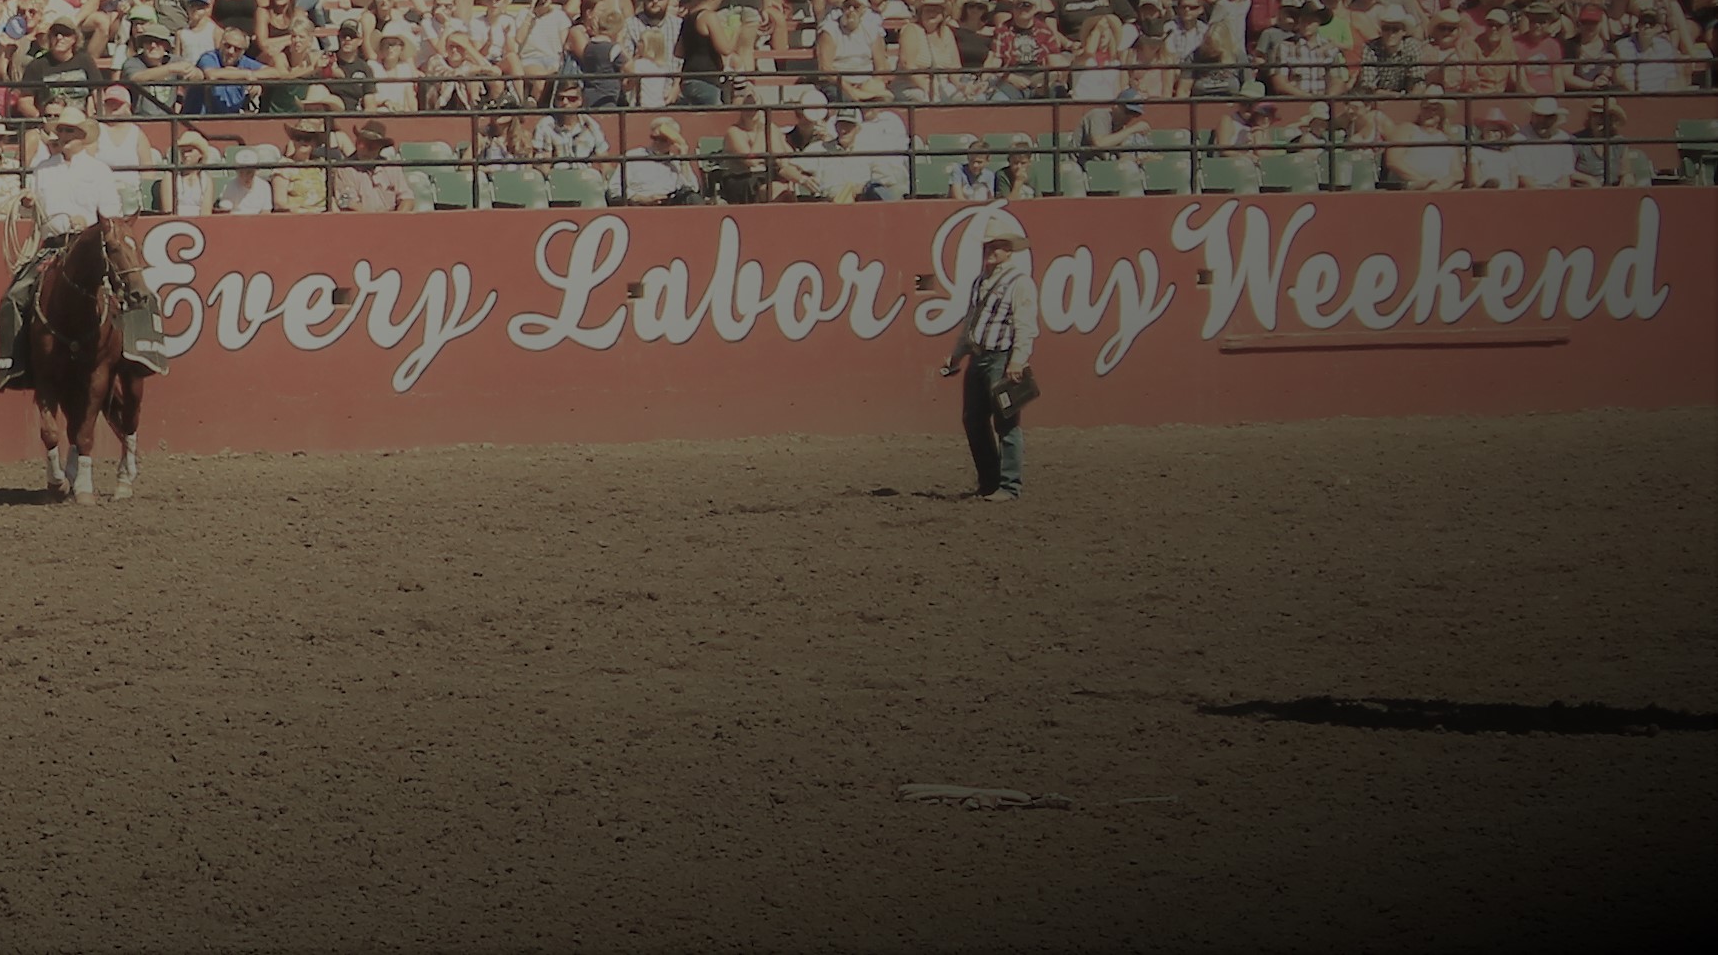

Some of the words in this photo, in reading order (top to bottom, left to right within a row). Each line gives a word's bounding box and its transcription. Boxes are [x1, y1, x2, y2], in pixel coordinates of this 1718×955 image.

[144, 220, 498, 394] Every
[505, 214, 907, 353] Labor
[913, 199, 1177, 377] Day
[1170, 195, 1671, 341] Weekend
